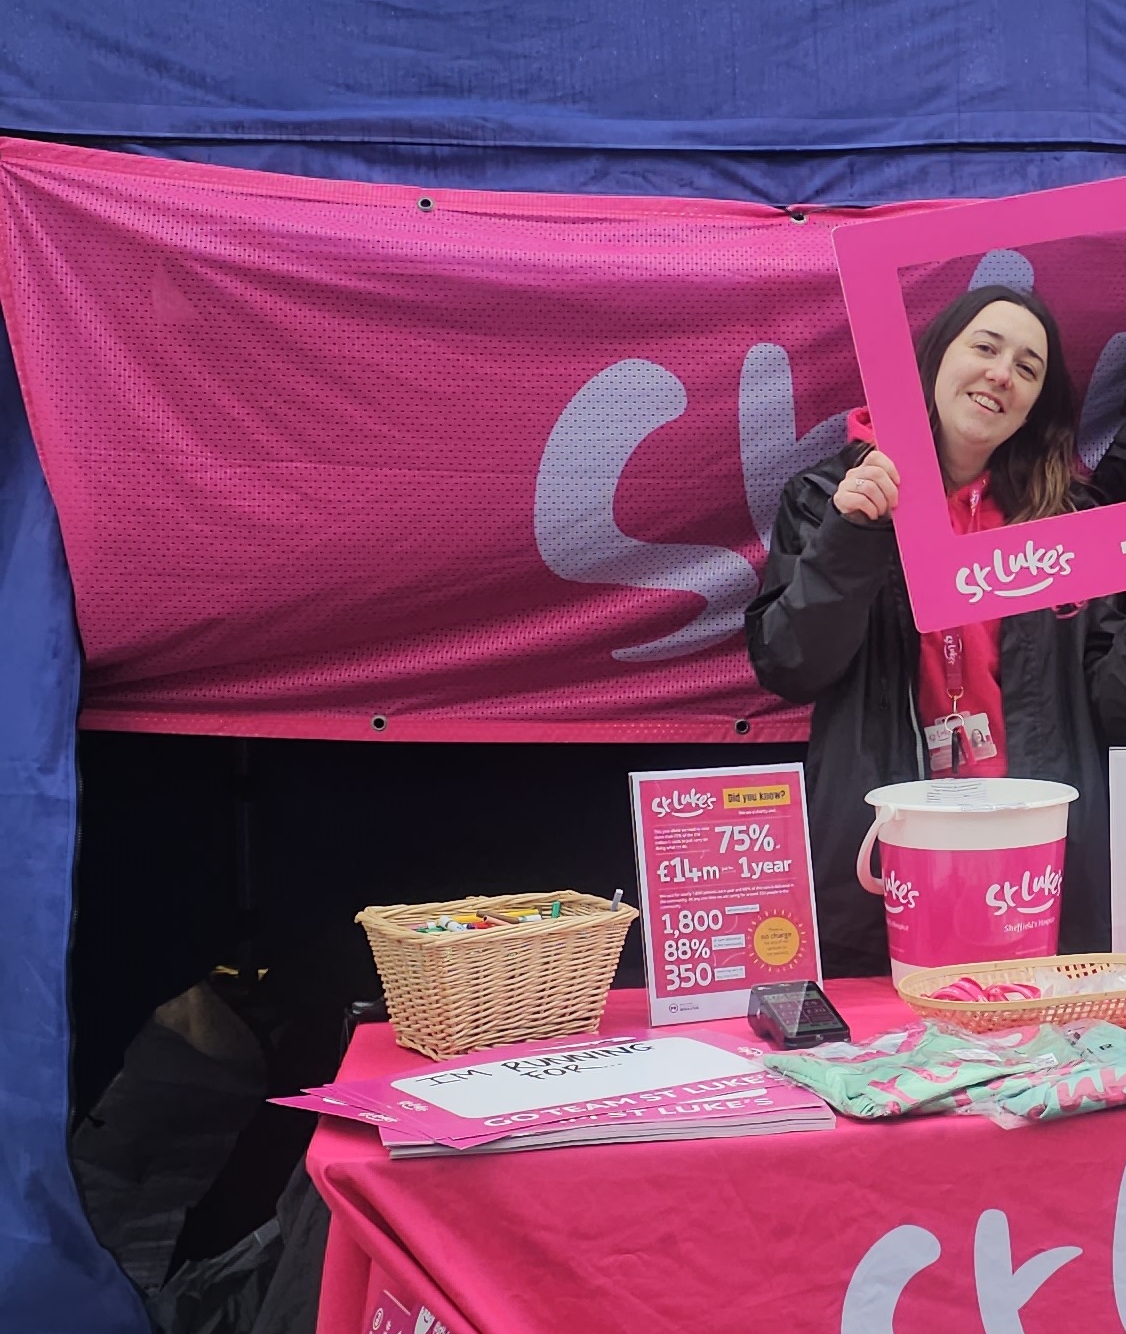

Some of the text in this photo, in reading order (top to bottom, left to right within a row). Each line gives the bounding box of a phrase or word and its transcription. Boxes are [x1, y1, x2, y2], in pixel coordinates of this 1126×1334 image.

[956, 540, 1075, 603] St Luke's
[652, 788, 716, 817] St Luke's
[728, 789, 786, 803] Did you know?
[714, 823, 774, 853] 75%
[657, 857, 720, 883] £14m
[884, 870, 920, 909] uke's
[986, 865, 1062, 915] St Luke's
[662, 909, 722, 938] 1,800
[664, 939, 710, 961] 88%
[664, 963, 712, 991] 350
[500, 1043, 655, 1072] RUNNING
[484, 1113, 540, 1127] GO
[540, 1097, 637, 1115] TEAM
[640, 1089, 677, 1102] ST
[658, 1097, 774, 1115] LUKE'S
